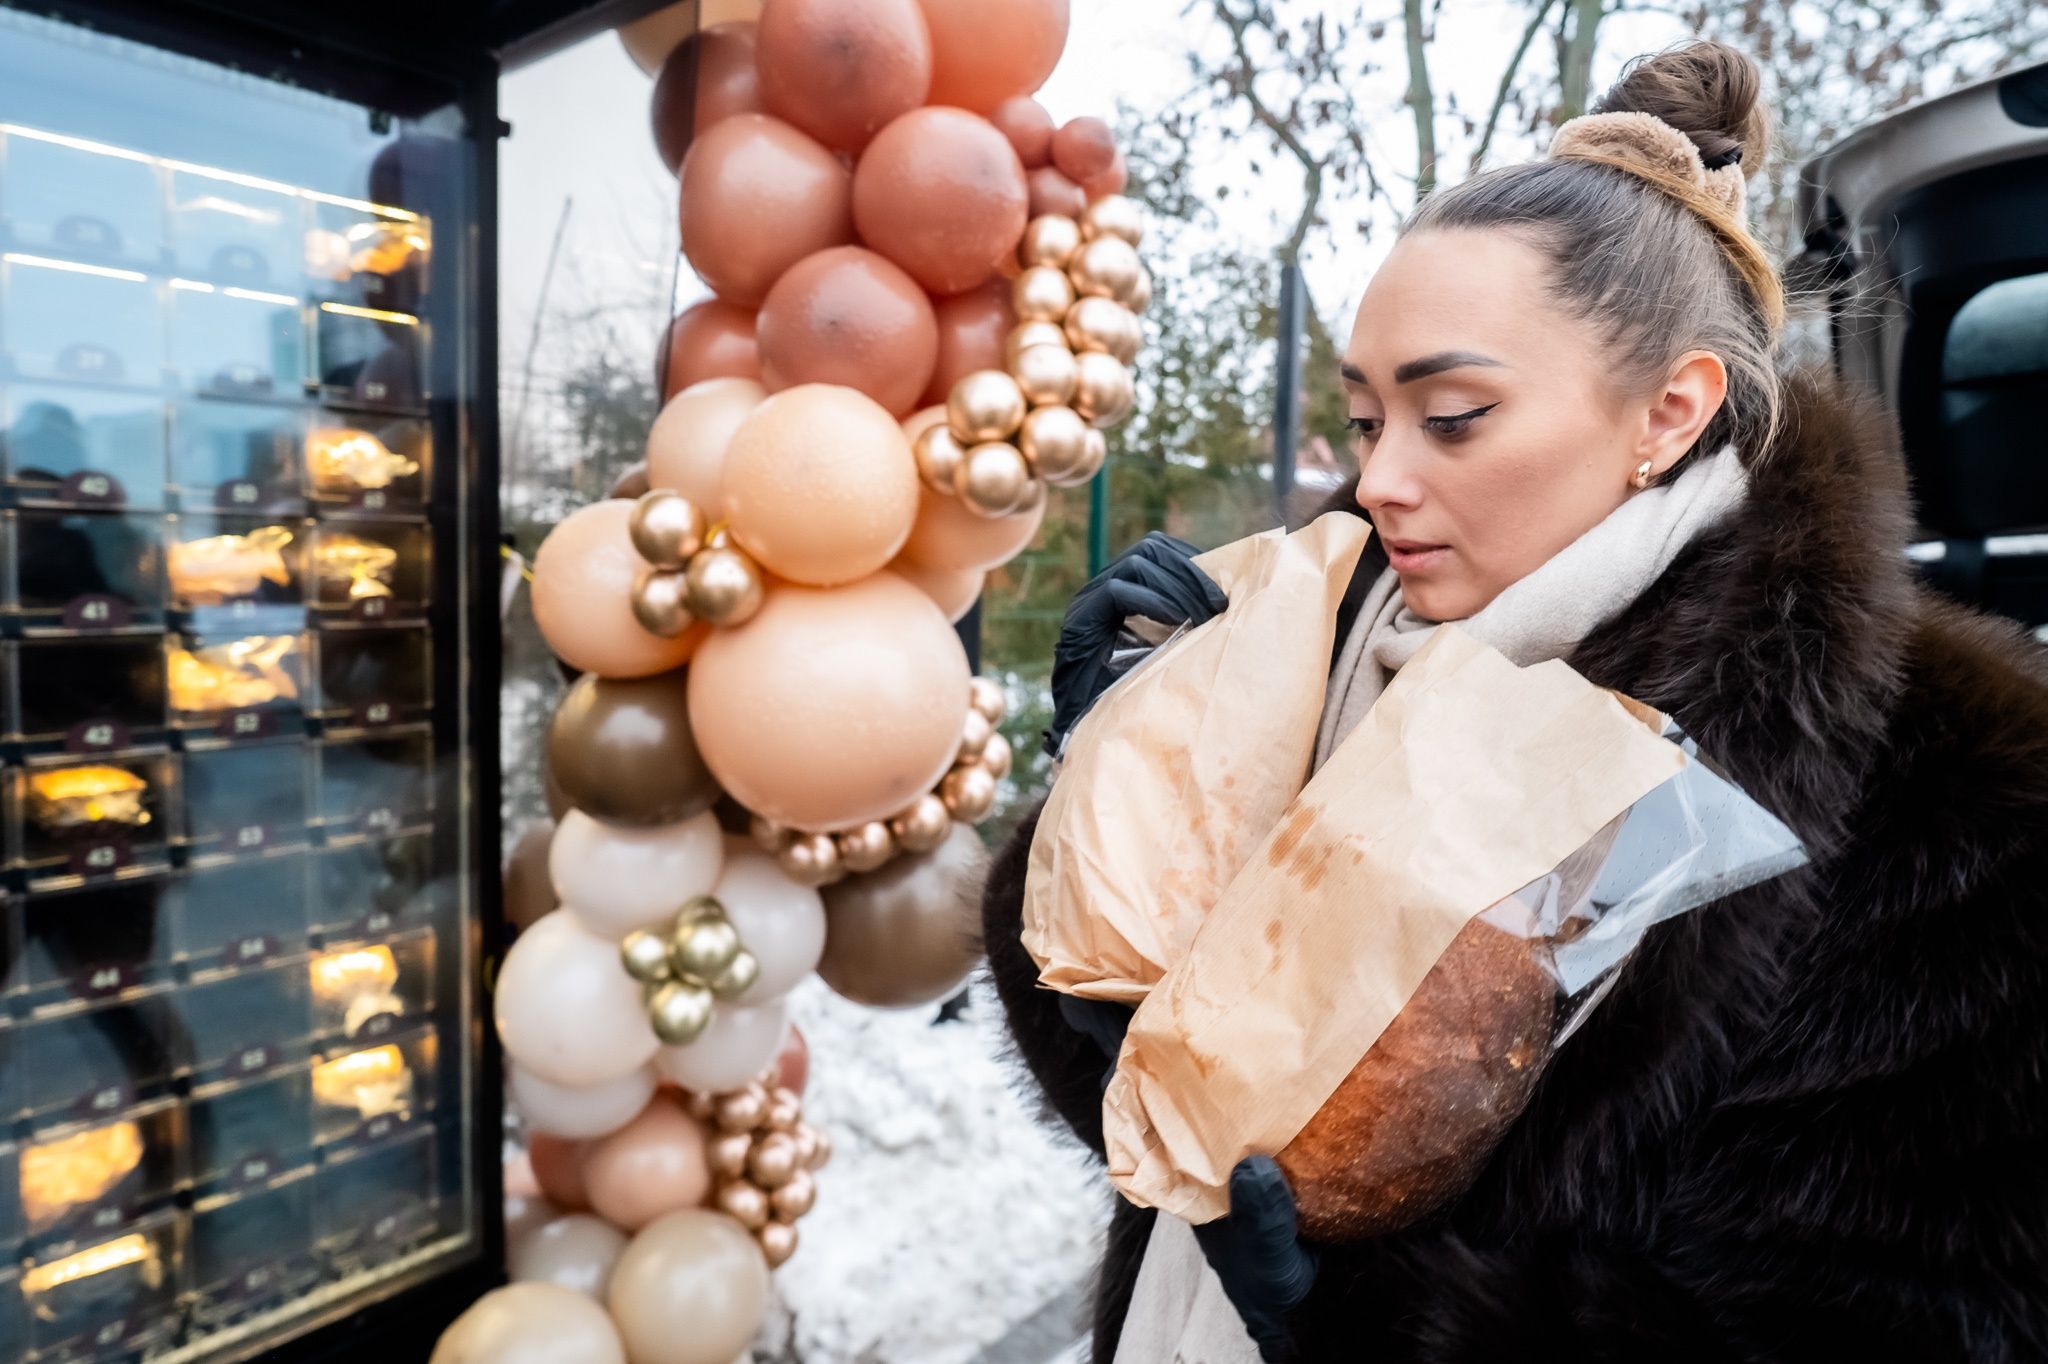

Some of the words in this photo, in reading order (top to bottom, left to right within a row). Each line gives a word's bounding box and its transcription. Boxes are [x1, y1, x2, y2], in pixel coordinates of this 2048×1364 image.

[79, 476, 109, 497] 40
[81, 601, 109, 620] 41
[366, 703, 390, 722] 62
[84, 724, 113, 745] 42
[86, 846, 116, 867] 43
[90, 967, 120, 989] 44
